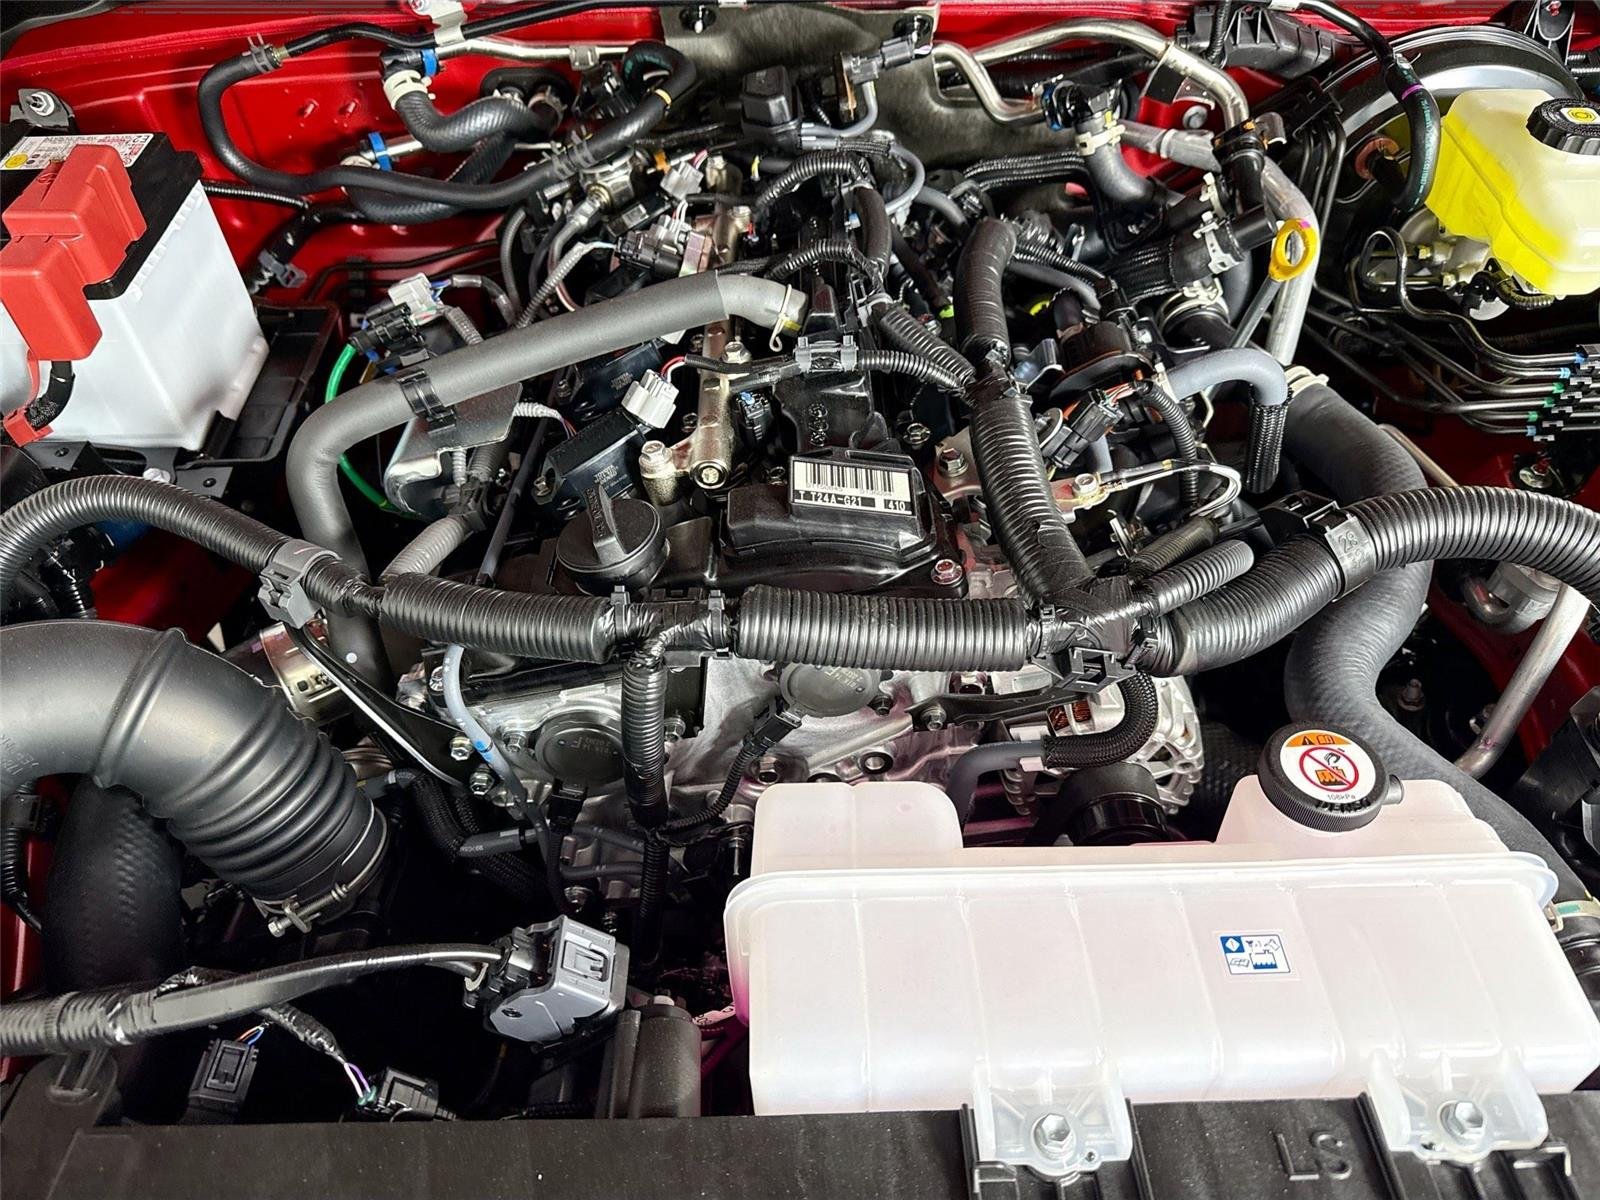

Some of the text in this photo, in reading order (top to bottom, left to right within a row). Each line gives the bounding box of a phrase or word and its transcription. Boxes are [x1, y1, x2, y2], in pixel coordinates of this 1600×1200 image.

[810, 492, 862, 507] T24A-G21
[888, 501, 906, 511] 410
[1338, 529, 1358, 553] 28
[1273, 1130, 1352, 1181] LS
